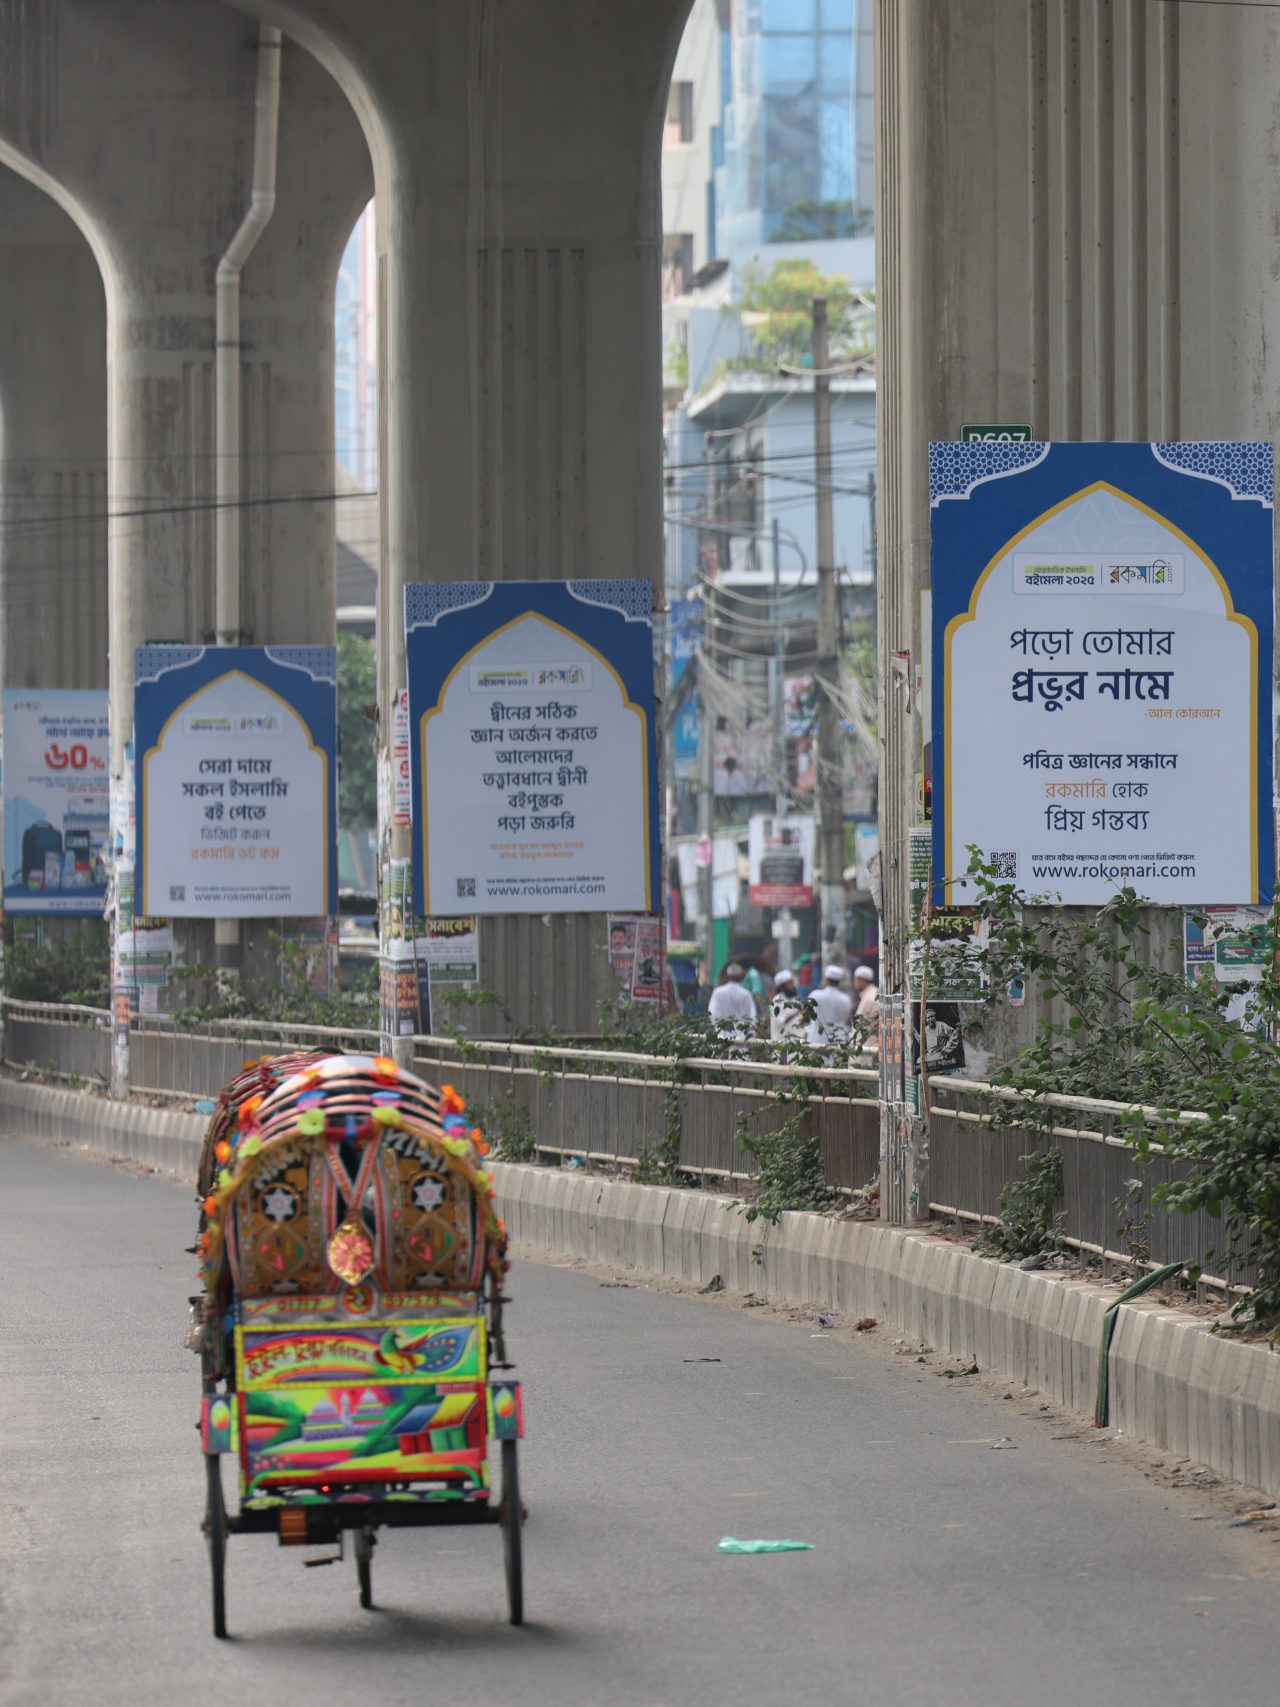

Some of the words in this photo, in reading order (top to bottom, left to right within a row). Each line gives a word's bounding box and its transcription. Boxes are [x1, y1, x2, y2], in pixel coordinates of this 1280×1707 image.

[1025, 574, 1063, 586] বইমেলা
[1066, 576, 1095, 586] ২০২৫
[1109, 559, 1167, 584] রকমারি
[1010, 629, 1073, 660] পড়ো
[1083, 629, 1175, 655] তোমার
[1012, 668, 1088, 712] প্রভুর
[1096, 668, 1174, 700] নামে
[490, 702, 531, 722] দ্বীনের
[536, 702, 578, 719] সঠিক
[1175, 709, 1221, 718] কোরআন
[470, 728, 504, 743] জ্ঞান
[508, 725, 551, 742] অর্জন
[556, 726, 598, 741] করতে
[199, 758, 232, 774] সেরা
[237, 758, 272, 774] দামে
[496, 749, 574, 764] আলেমদের
[1022, 750, 1064, 769] পবিত্র
[1068, 753, 1123, 770] জ্ঞানের
[1126, 753, 1178, 770] সন্ধানে
[182, 782, 224, 798] সকল
[229, 778, 289, 798] ইসলামি
[1044, 778, 1107, 798] রকমারি
[1112, 781, 1149, 798] হোক
[508, 792, 564, 811] বইপুস্তক
[204, 803, 224, 821] বই
[229, 805, 266, 821] পেতে
[1044, 805, 1085, 832] প্রিয়
[1092, 809, 1150, 831] গন্তব্য
[498, 816, 525, 833] পড়া
[530, 812, 575, 831] জরুরি
[1032, 863, 1196, 878] www.rokomari.com
[487, 882, 605, 897] www.rokomari.com
